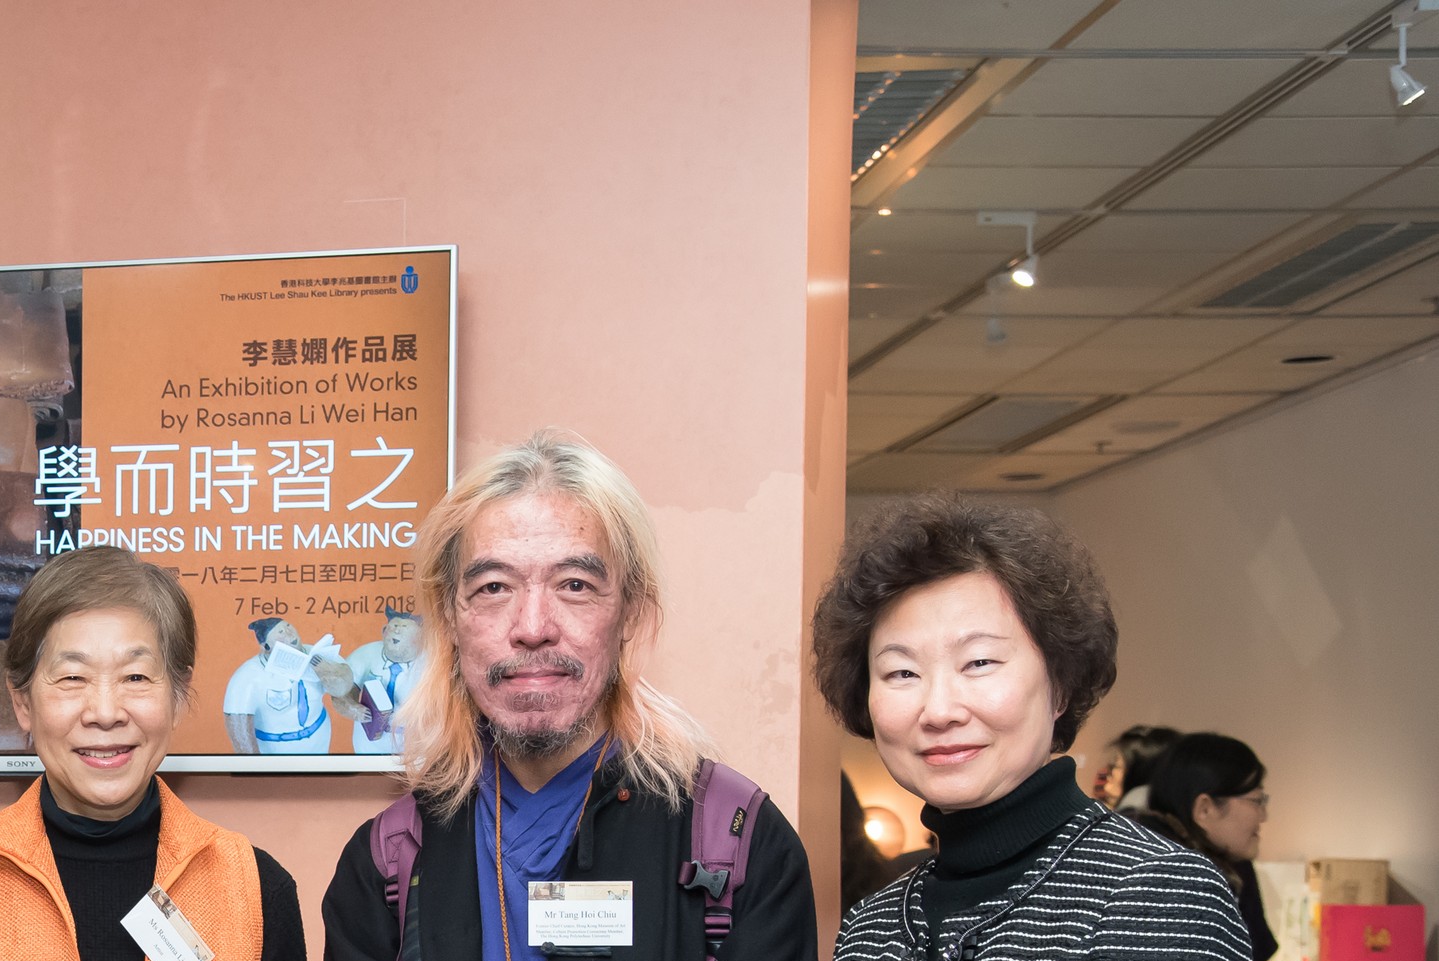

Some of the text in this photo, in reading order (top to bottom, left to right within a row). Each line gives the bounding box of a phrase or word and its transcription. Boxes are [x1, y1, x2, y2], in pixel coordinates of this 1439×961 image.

[220, 287, 397, 302] The HKUST Lee Shau Kee Library presents
[241, 333, 418, 368] 李慧嫻作品展
[160, 371, 418, 399] An Exhibition of Works
[161, 402, 418, 434] by Rosanna Li Wei Han
[33, 435, 418, 519] 學而時習之
[35, 521, 417, 555] HAPPINESS IN THE MAKING
[234, 598, 245, 616] 7
[250, 597, 289, 616] Feb
[306, 597, 317, 615] 2
[321, 596, 370, 619] April
[374, 595, 416, 615] 2018
[6, 760, 36, 768] SONY
[544, 910, 617, 920] Mr Tang Hoi Chiu
[148, 918, 158, 931] Ms
[157, 929, 178, 957] Rosanna
